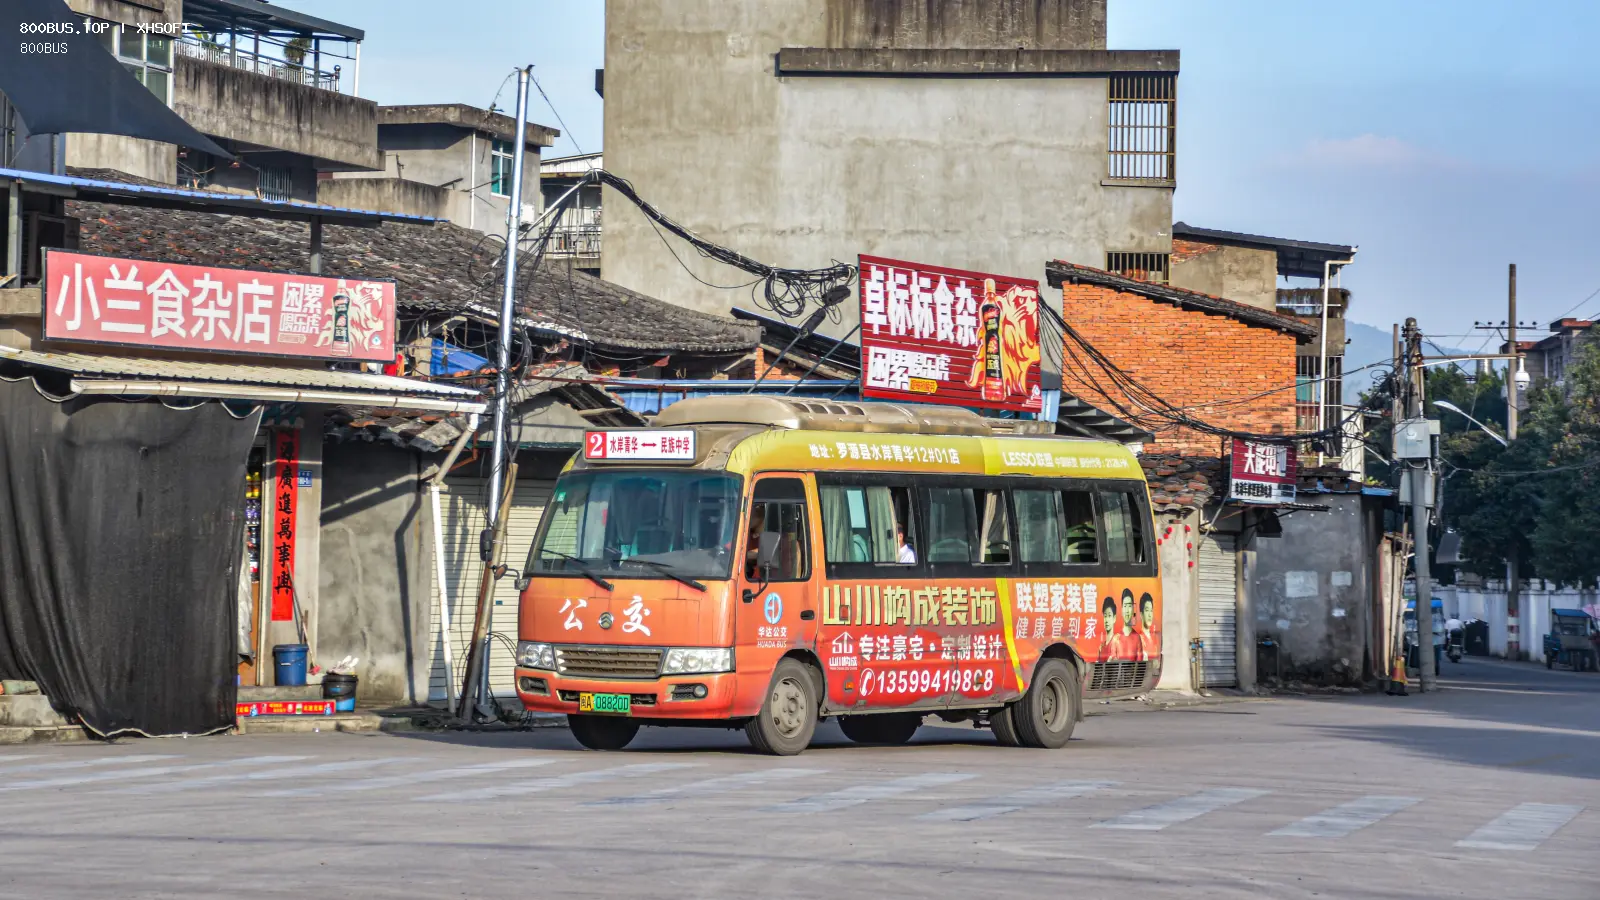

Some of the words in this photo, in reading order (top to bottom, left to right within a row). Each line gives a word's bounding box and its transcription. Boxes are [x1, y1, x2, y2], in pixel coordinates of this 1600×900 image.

[55, 263, 273, 345] 小兰食杂店
[281, 281, 324, 314] 困累
[864, 265, 977, 347] 卓标标食杂
[589, 433, 604, 457] 2
[609, 436, 639, 454] 水岸菁华
[660, 436, 690, 454] 民族中学
[823, 584, 997, 627] 山川构成装饰
[1015, 582, 1098, 614] 联塑家装管
[757, 626, 788, 638] 华达公交
[1015, 616, 1098, 640] 健康管到家
[757, 640, 776, 649] HUADA
[776, 640, 787, 649] BUS
[828, 656, 858, 667] 山川构成
